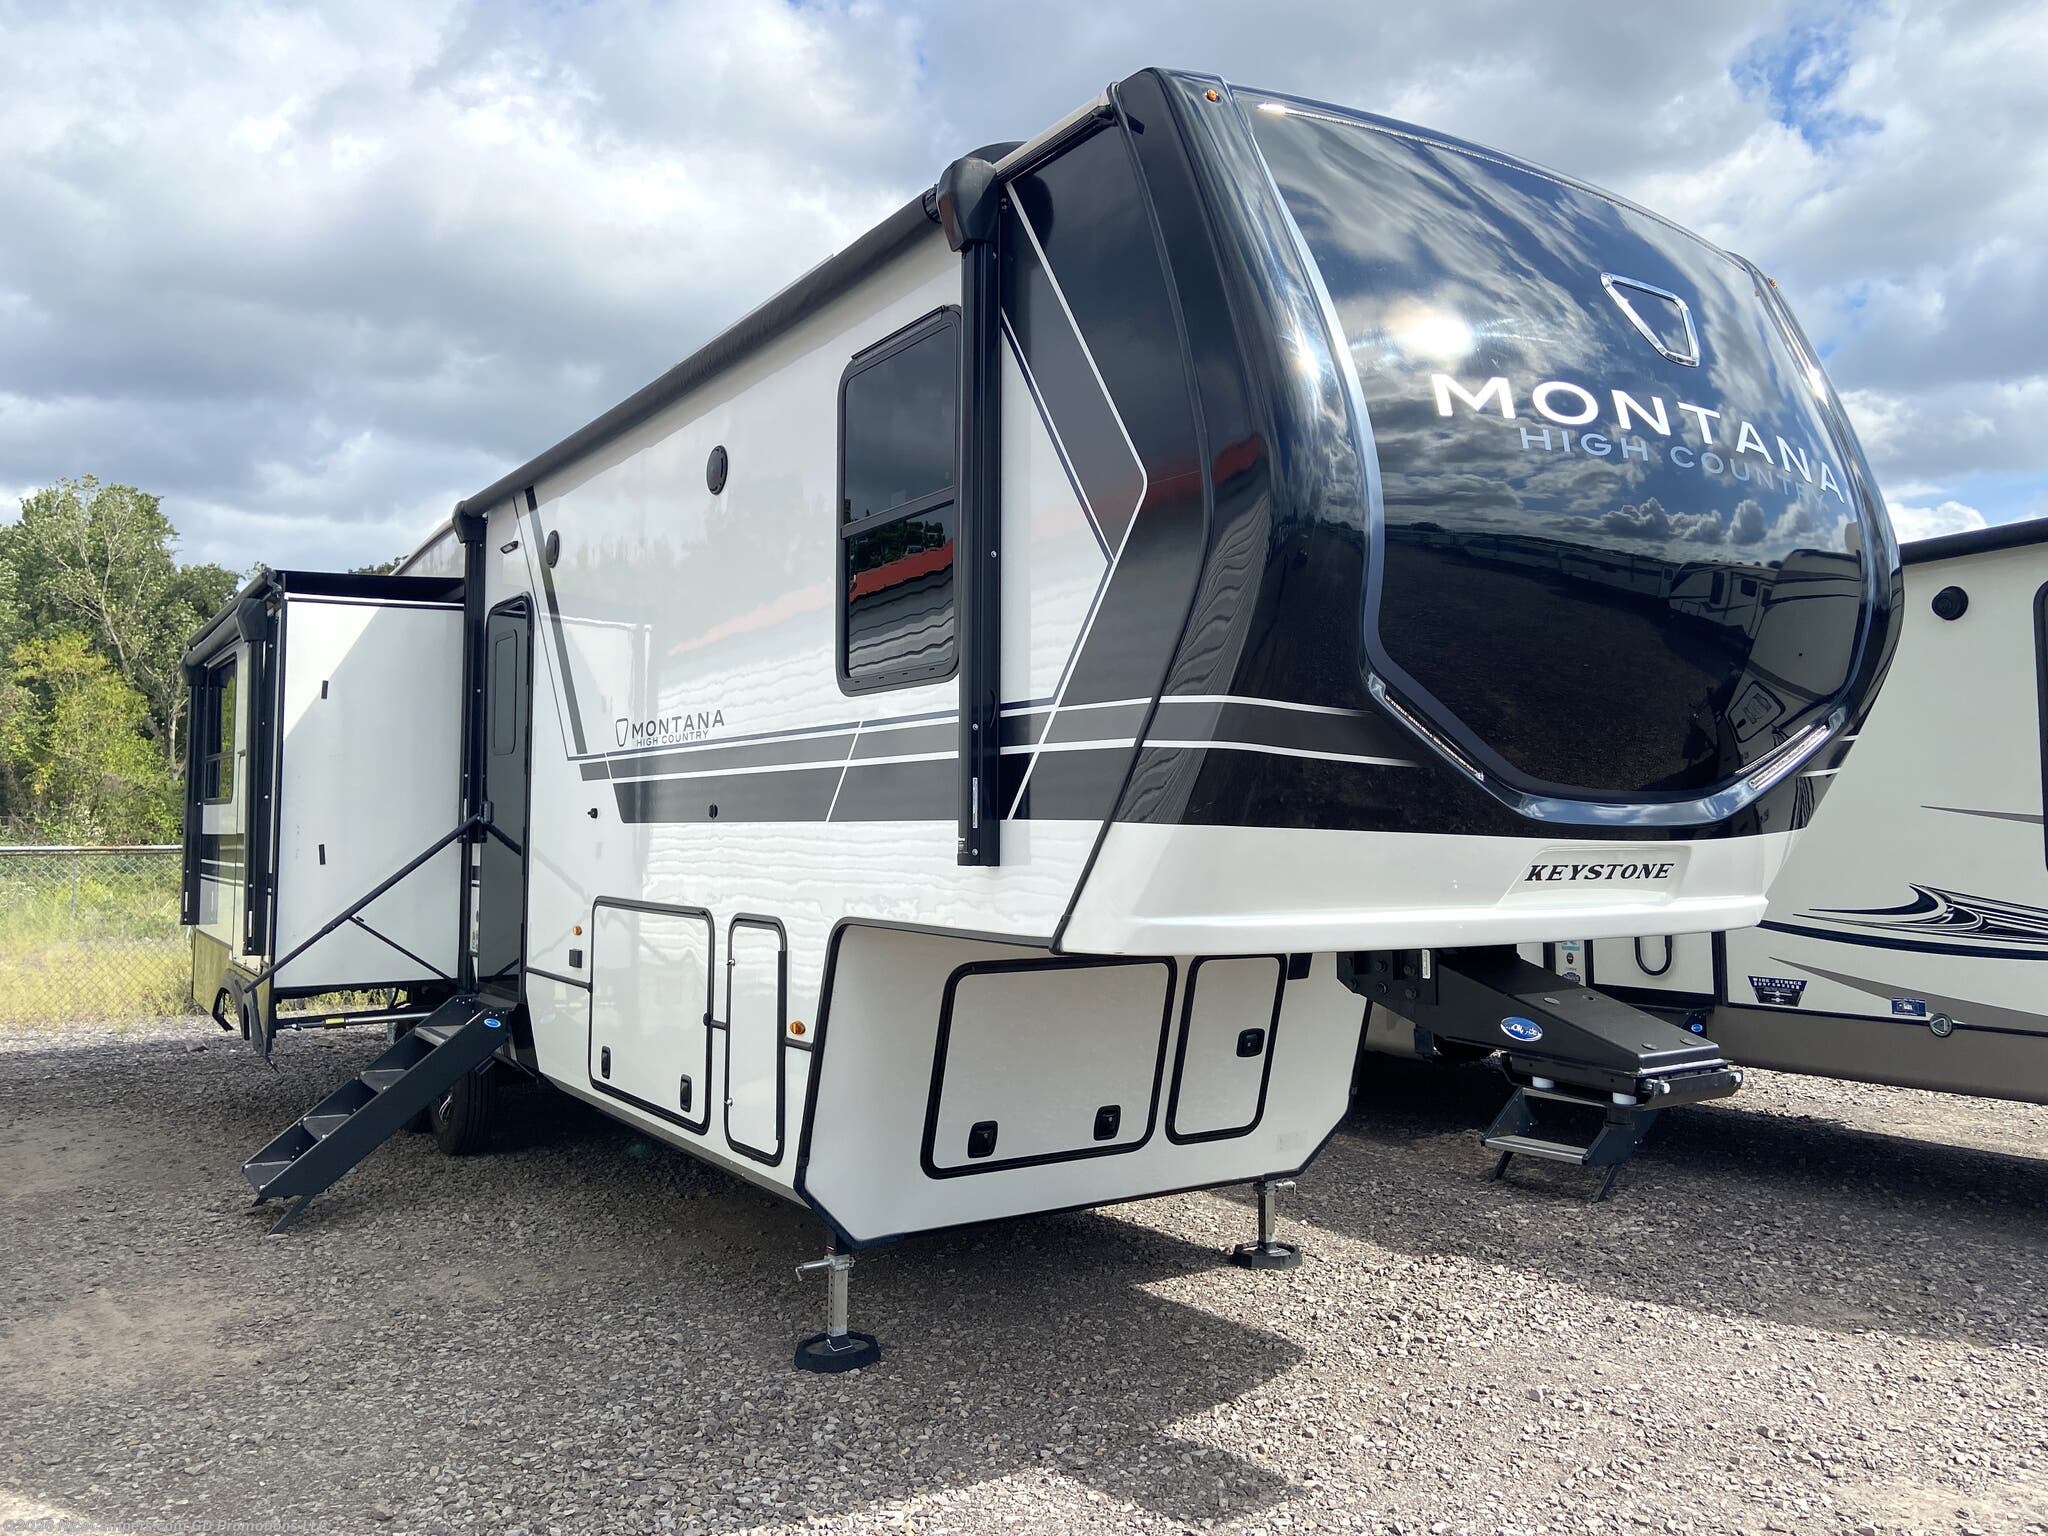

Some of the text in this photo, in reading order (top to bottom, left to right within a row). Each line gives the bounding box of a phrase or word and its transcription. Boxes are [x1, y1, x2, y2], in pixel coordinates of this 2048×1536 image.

[1431, 374, 1844, 504] MONTANA
[1519, 427, 1649, 461] HIGH
[632, 709, 725, 738] MONTANA
[637, 729, 709, 747] HIGH COUNTRY
[1524, 863, 1674, 881] KEYSTONE
